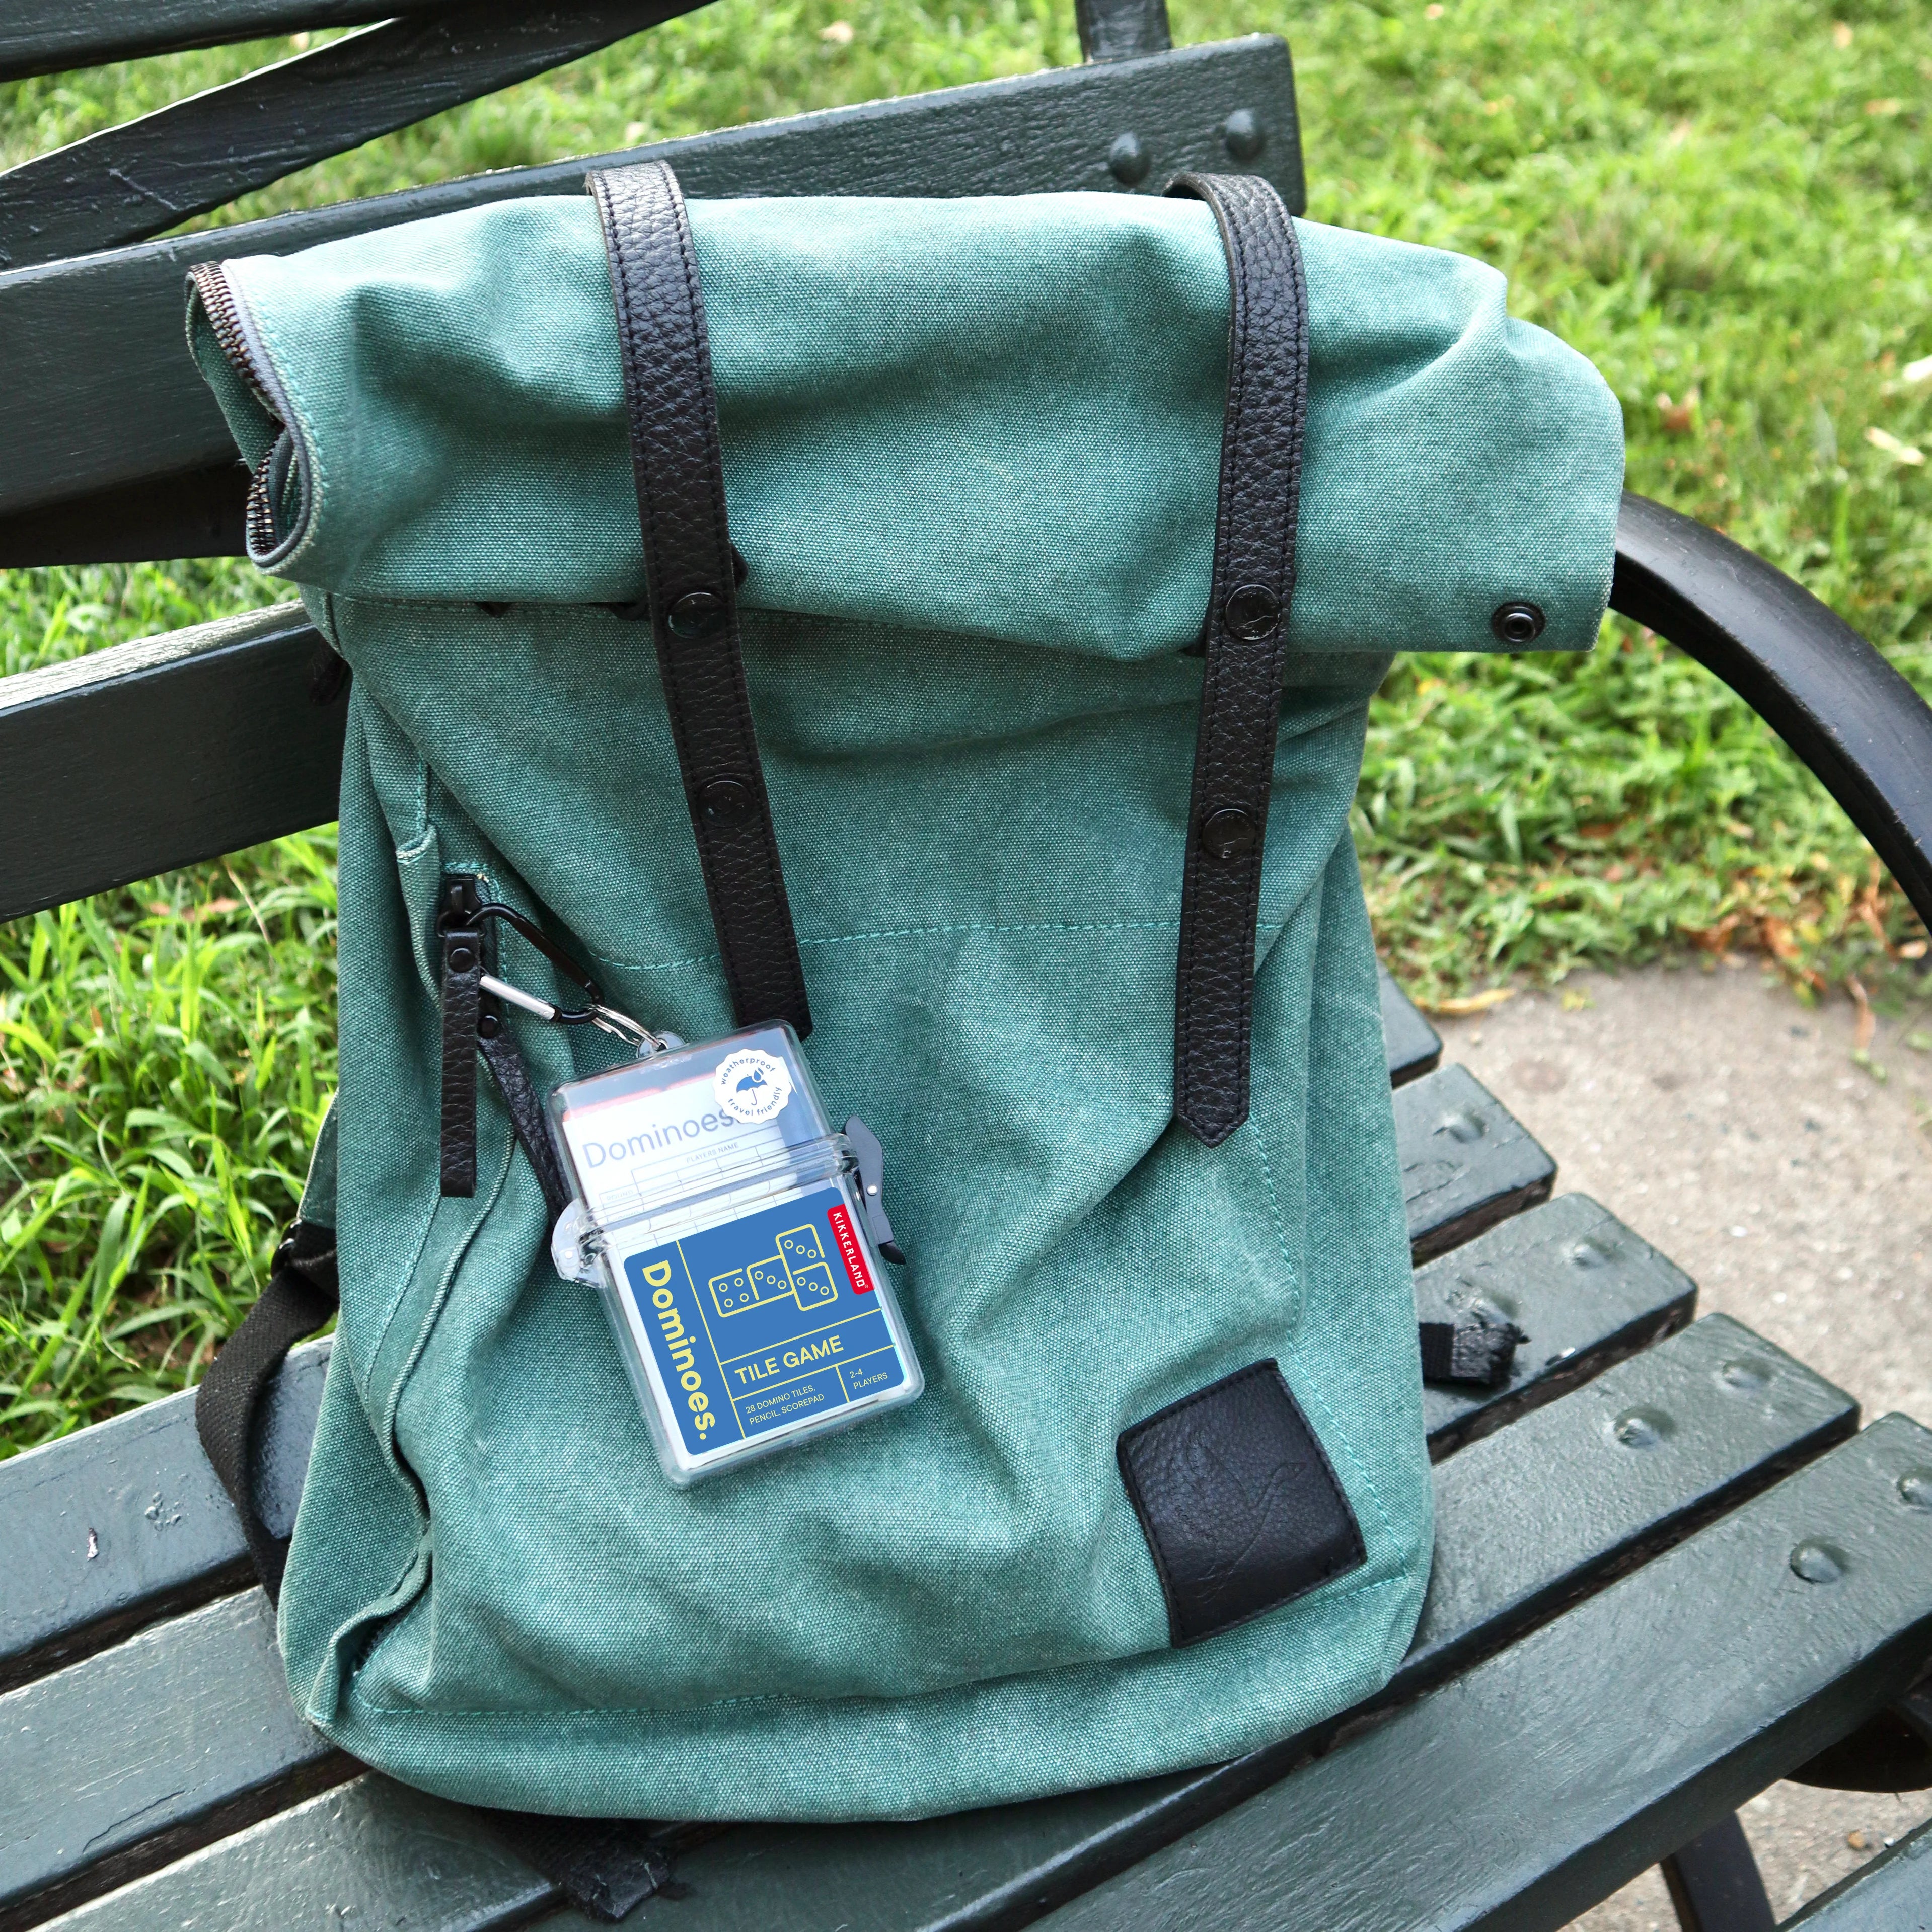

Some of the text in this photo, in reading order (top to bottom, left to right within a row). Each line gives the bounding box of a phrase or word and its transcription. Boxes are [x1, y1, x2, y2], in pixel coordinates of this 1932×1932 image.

[721, 1058, 776, 1085] weatherproof
[728, 1087, 782, 1116] travel friendly
[718, 1142, 739, 1153] NAME
[642, 1260, 715, 1440] Dominoes.
[734, 1335, 844, 1384] TILE GAME
[849, 1368, 863, 1379] 2-4
[853, 1372, 888, 1389] PLAYERS
[745, 1385, 816, 1414] 28 DOMINO TILES,
[749, 1394, 824, 1425] PENCIL, SCOREPAD
